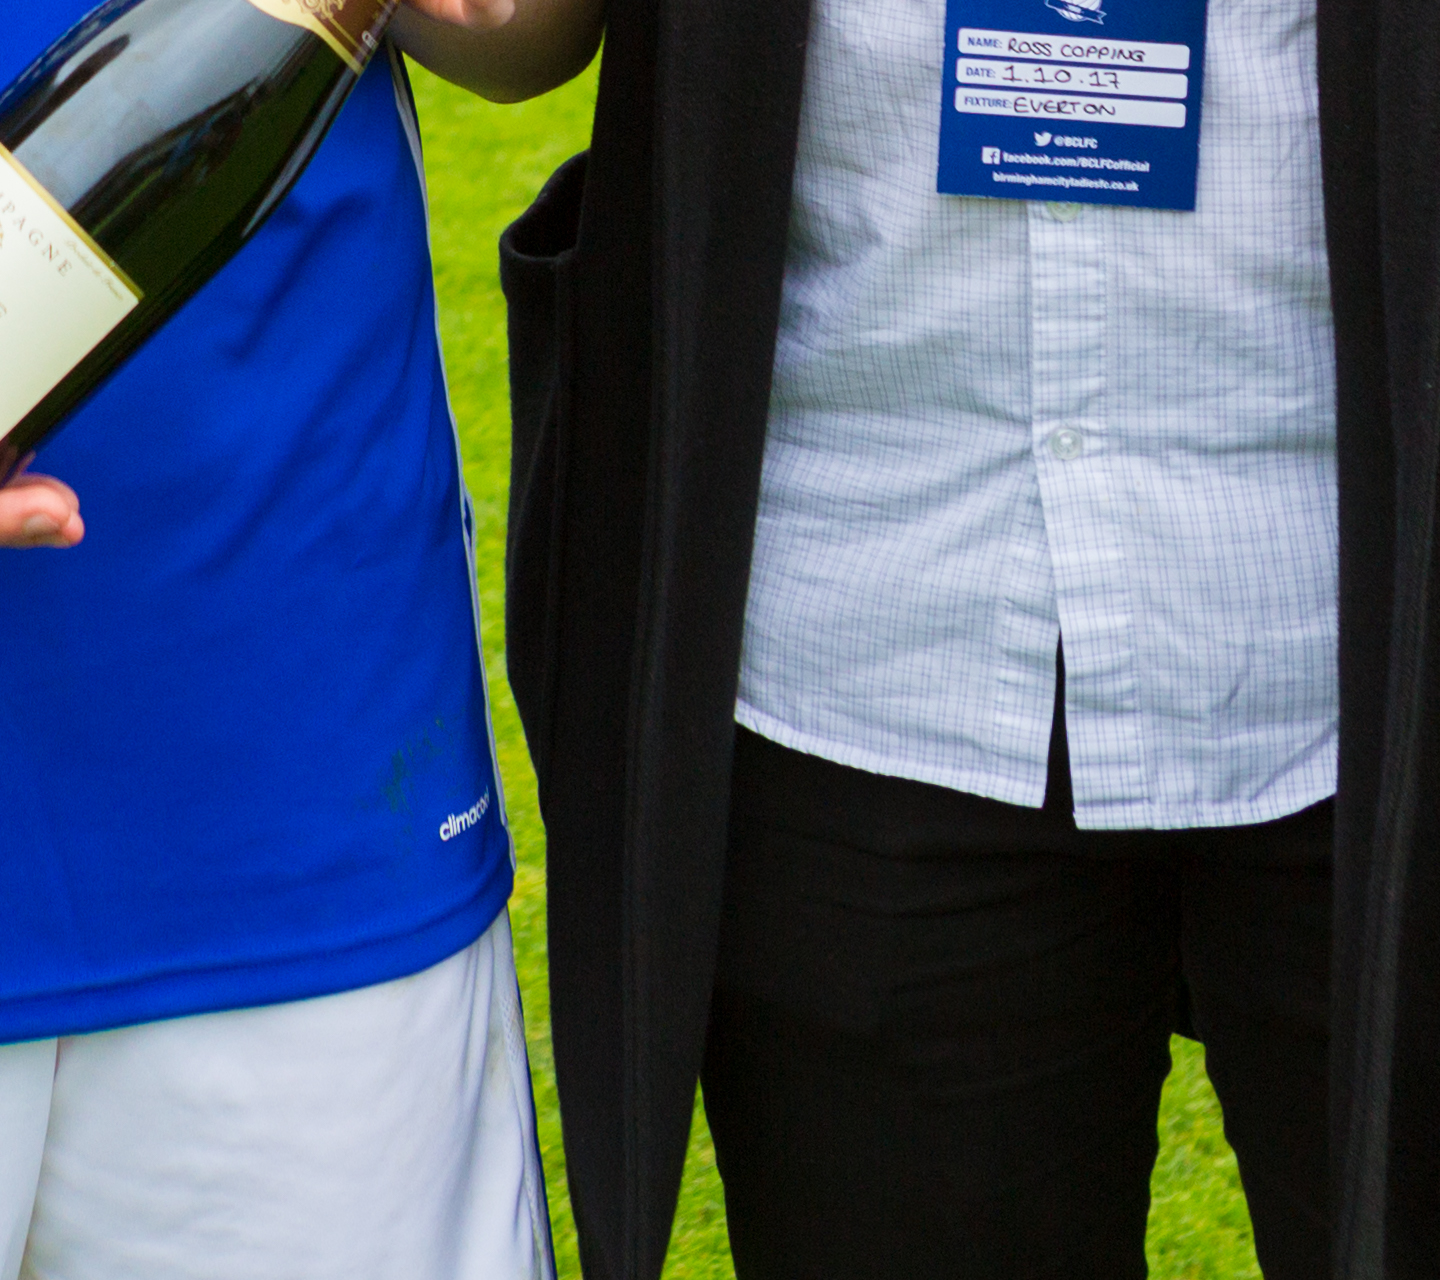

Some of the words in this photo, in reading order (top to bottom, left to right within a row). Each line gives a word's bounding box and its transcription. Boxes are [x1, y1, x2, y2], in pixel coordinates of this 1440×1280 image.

[967, 37, 1002, 49] NAME:
[1007, 37, 1053, 57] ROSS
[1060, 43, 1146, 63] COPPING
[965, 66, 996, 78] DATE:
[1013, 96, 1116, 116] EVERTON
